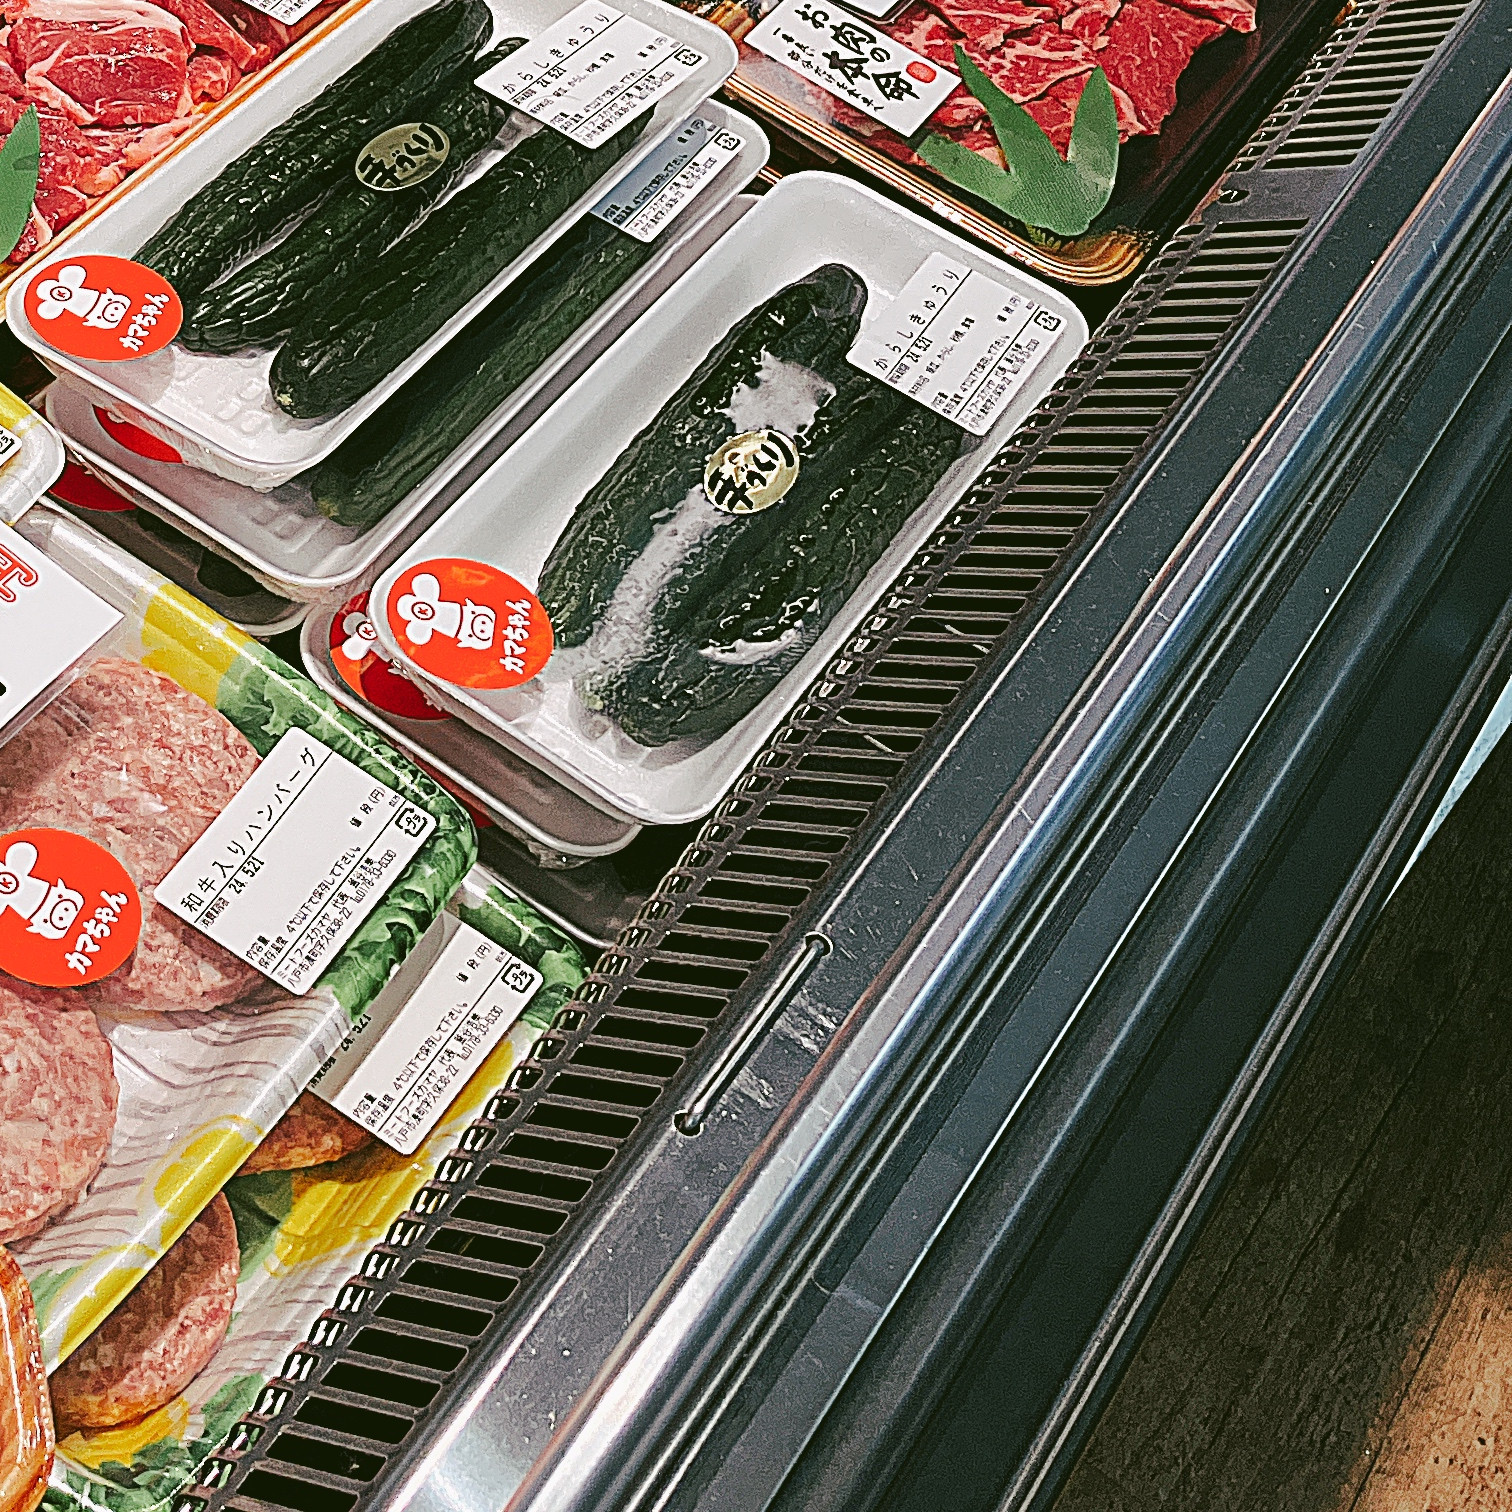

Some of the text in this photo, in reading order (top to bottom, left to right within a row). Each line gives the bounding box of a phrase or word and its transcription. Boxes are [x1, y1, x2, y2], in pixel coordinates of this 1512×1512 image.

[502, 12, 611, 95] からしきゅうり
[794, 2, 892, 65] お肉の
[821, 49, 921, 102] 本命
[119, 291, 173, 352] カマちゃん
[873, 268, 961, 372] からしきゅうり
[498, 598, 533, 677] カマちゃん
[181, 746, 319, 914] 和牛入りハンバーグ
[65, 890, 130, 977] カマちゃん
